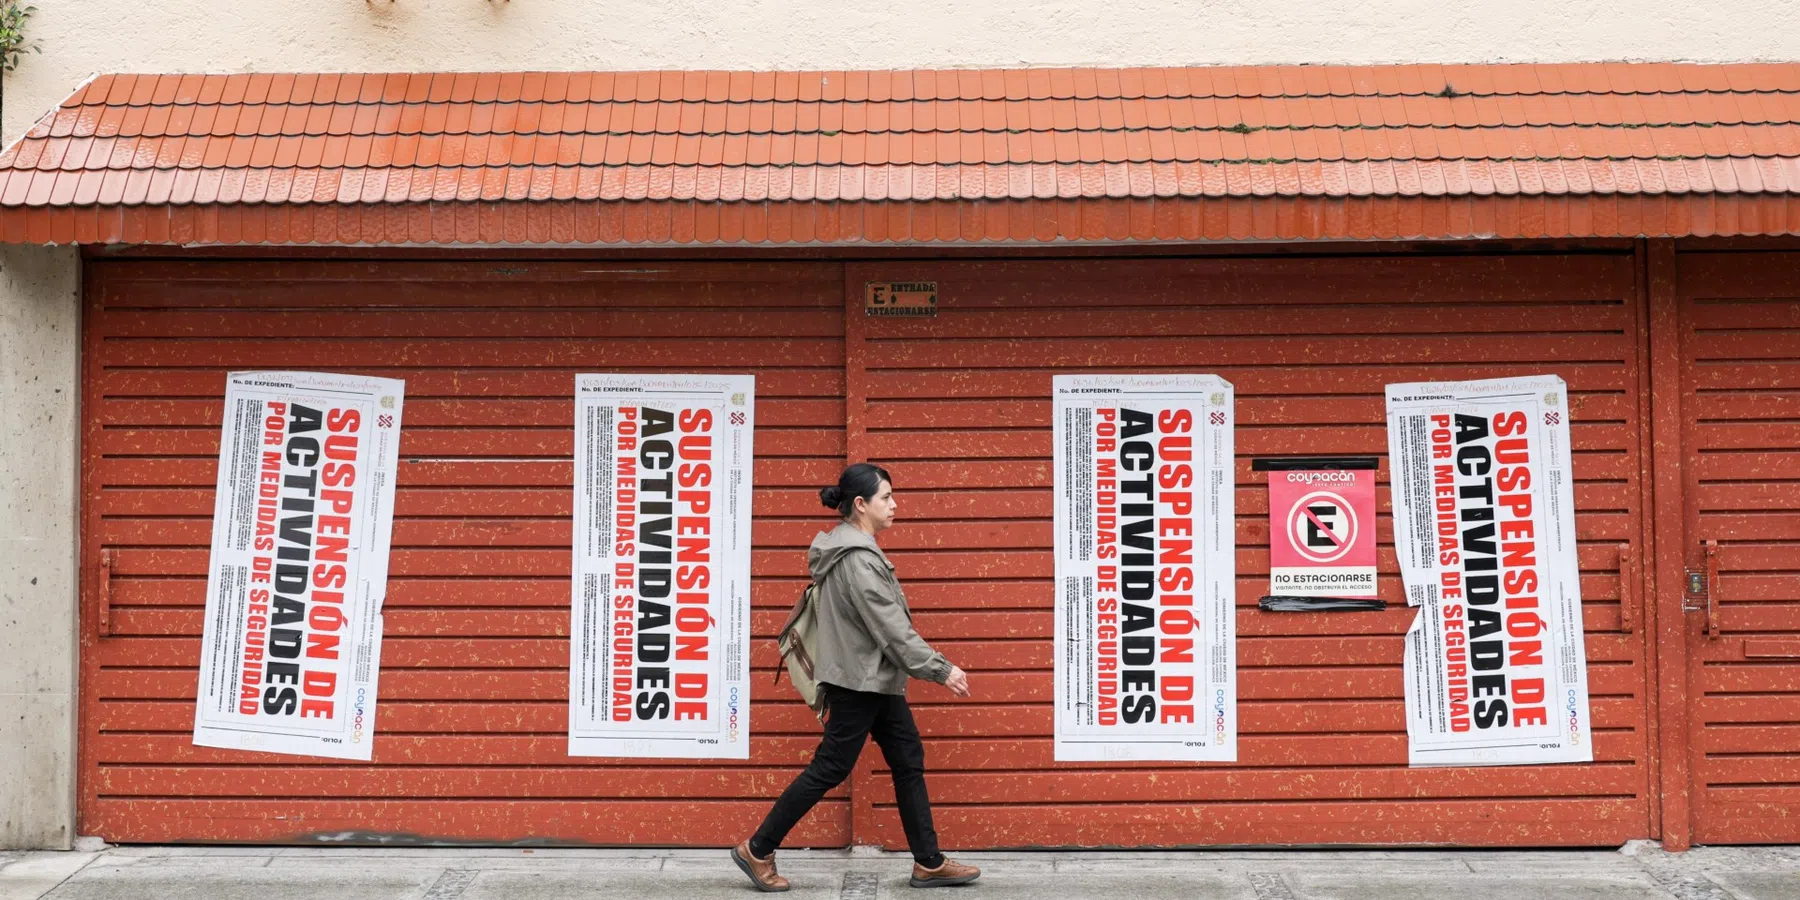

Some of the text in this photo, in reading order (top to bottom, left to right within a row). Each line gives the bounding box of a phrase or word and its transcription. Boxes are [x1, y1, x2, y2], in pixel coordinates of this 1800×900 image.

[868, 307, 936, 315] ESTACIONARSE
[874, 287, 885, 304] E
[891, 284, 935, 292] ENTRADA
[265, 402, 286, 445] POR
[1097, 408, 1116, 452] POR
[255, 452, 281, 550] MEDIDAS
[263, 403, 322, 715] ACTIVIDADES
[636, 407, 674, 720] ACTIVIDADES
[1097, 459, 1116, 559] MEDIDAS
[1307, 506, 1337, 546] E
[252, 557, 272, 582] DE
[301, 409, 360, 719] SUSPENSIÓN DE
[613, 407, 637, 721] POR MEDIDAS DE SEGURIDAD
[675, 409, 715, 720] SUSPENSIÓN DE
[1098, 566, 1116, 592] DE
[1120, 408, 1156, 724] ACTIVIDADES
[1158, 409, 1199, 724] SUSPENSIÓN DE
[1294, 574, 1372, 582] ESTACIONARSE
[1431, 415, 1470, 732] POR MEDIDAS DE SEGURIDAD
[1454, 414, 1508, 729] ACTIVIDADES
[1493, 411, 1547, 727] SUSPENSIÓN DE
[240, 590, 268, 715] SEGURIDAD
[1098, 598, 1117, 725] SEGURIDAD
